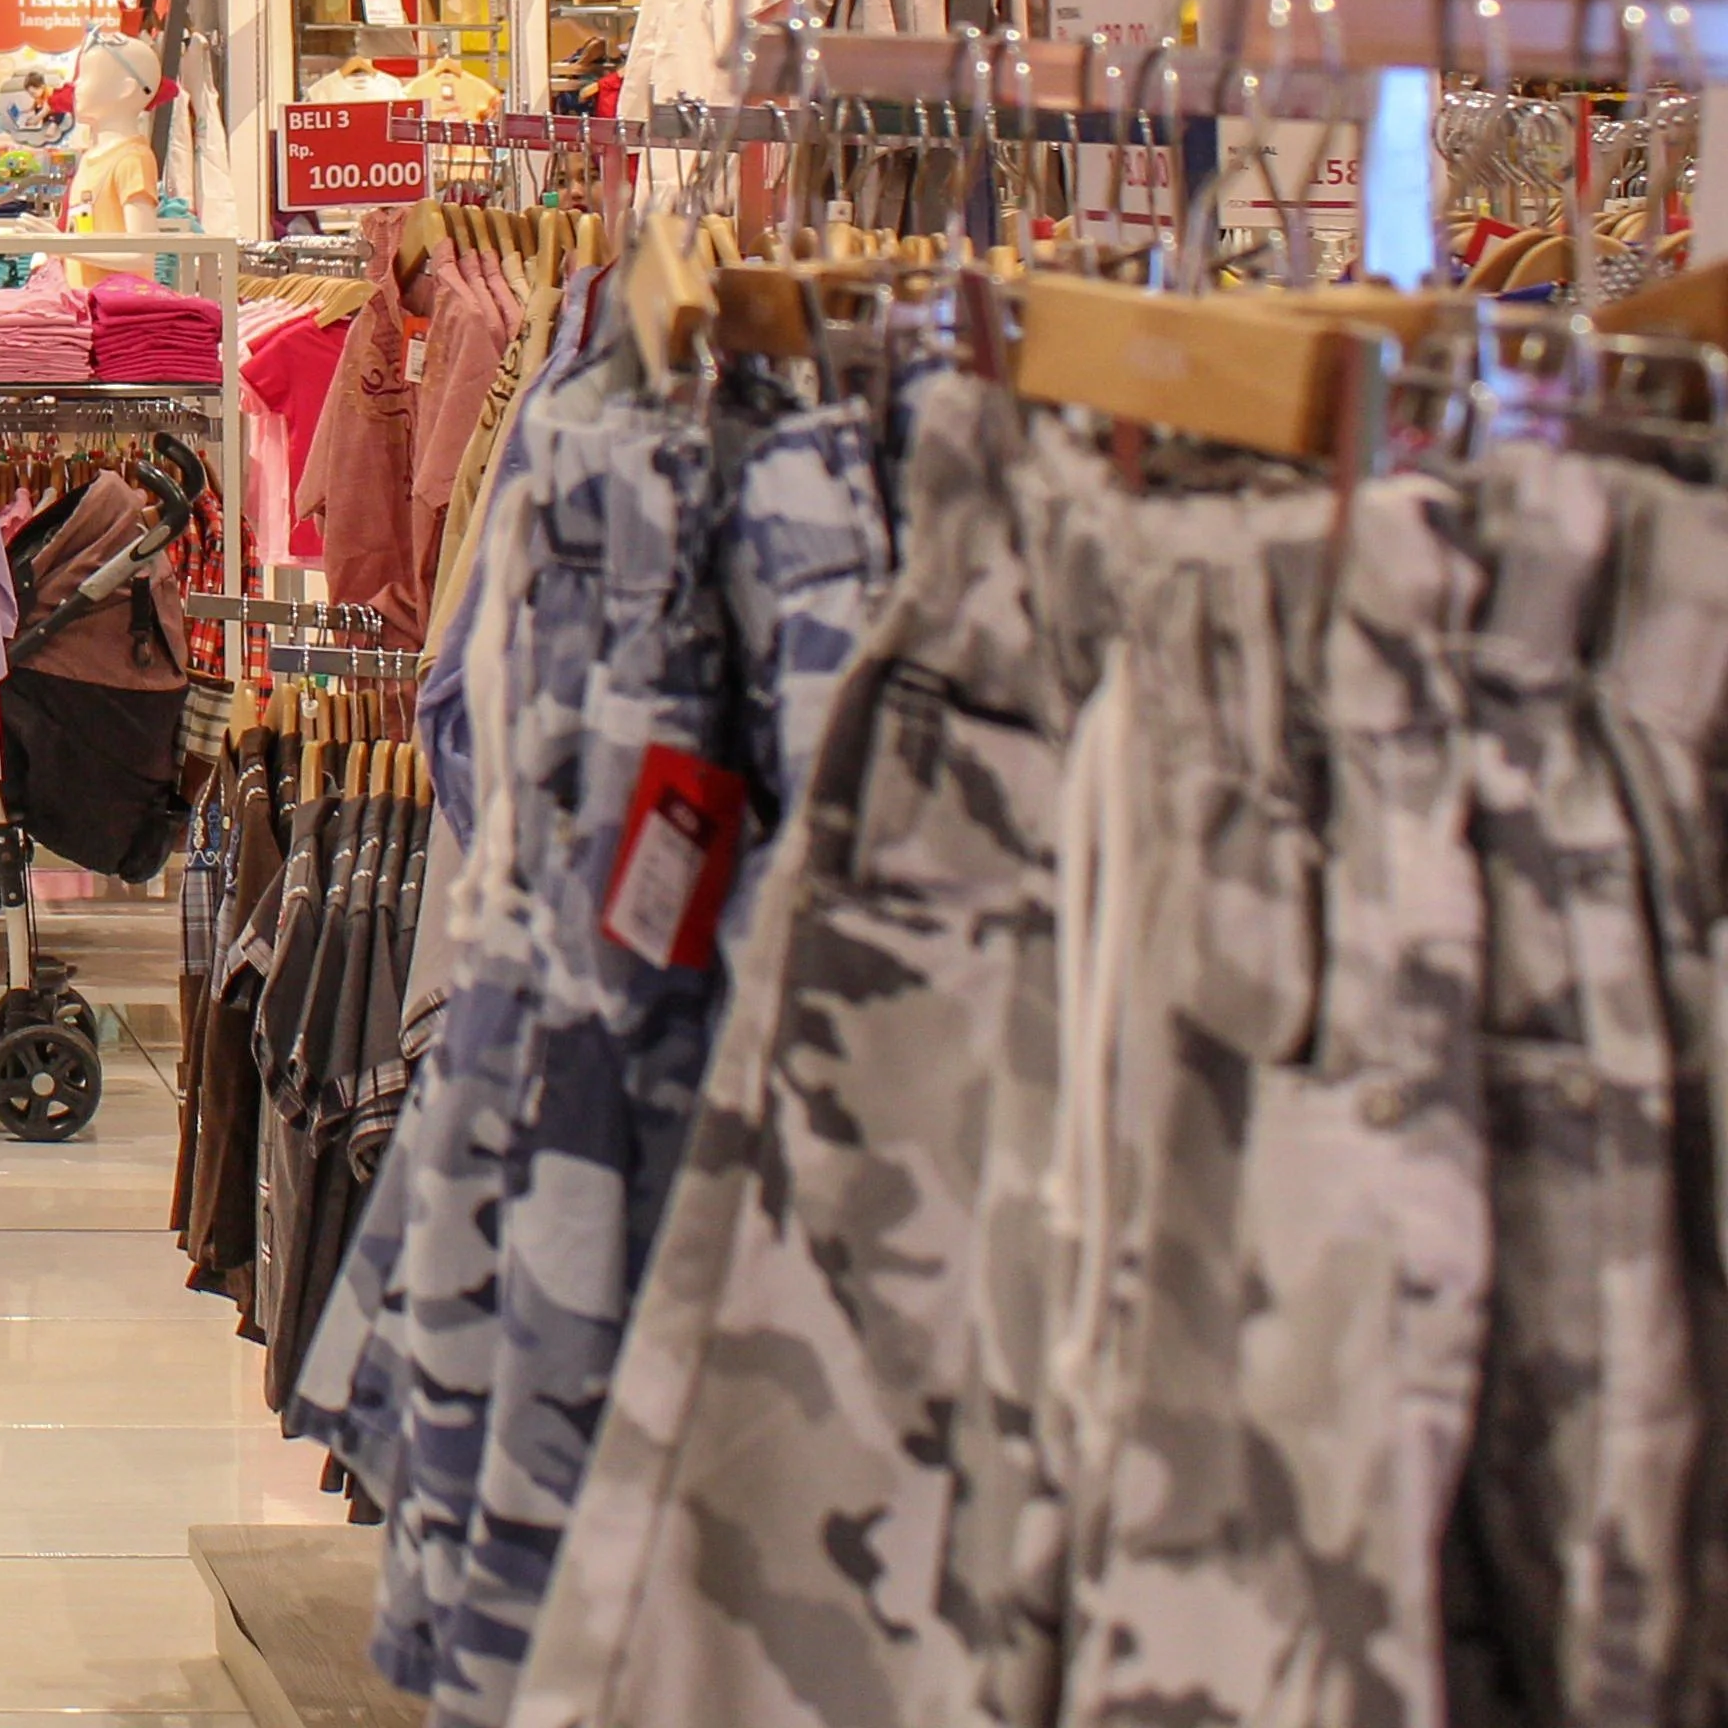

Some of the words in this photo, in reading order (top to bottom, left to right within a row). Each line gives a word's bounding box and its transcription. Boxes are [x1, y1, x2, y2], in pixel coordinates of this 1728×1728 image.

[20, 12, 81, 30] langkah
[289, 111, 332, 130] BELI
[337, 110, 350, 129] 3
[289, 143, 314, 159] Rp.
[309, 162, 422, 190] 100.000
